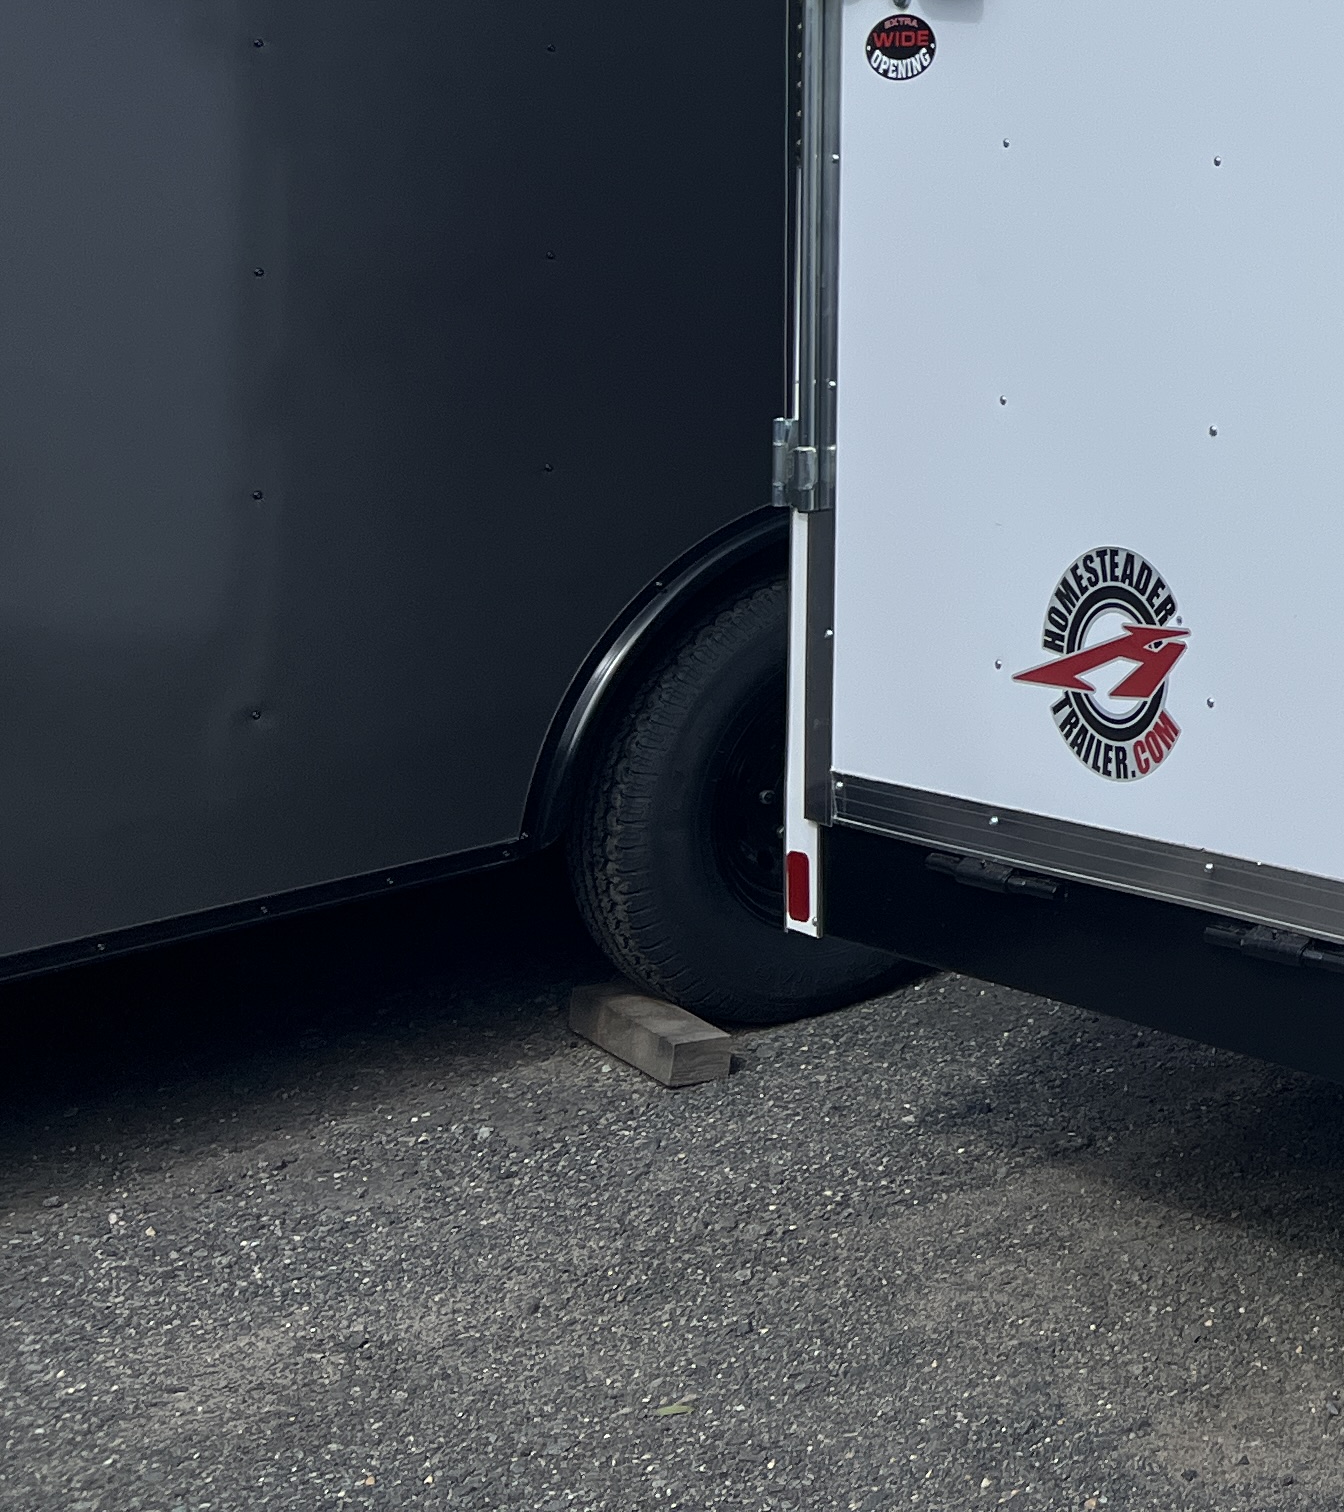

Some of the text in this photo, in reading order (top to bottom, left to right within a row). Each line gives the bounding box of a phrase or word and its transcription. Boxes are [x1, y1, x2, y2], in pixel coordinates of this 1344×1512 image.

[873, 29, 929, 47] WIDE
[884, 17, 918, 29] EXTRA
[870, 47, 931, 79] OPENING
[1042, 548, 1176, 653] HOMESTEADER
[1051, 690, 1179, 780] TRAILER.COM
